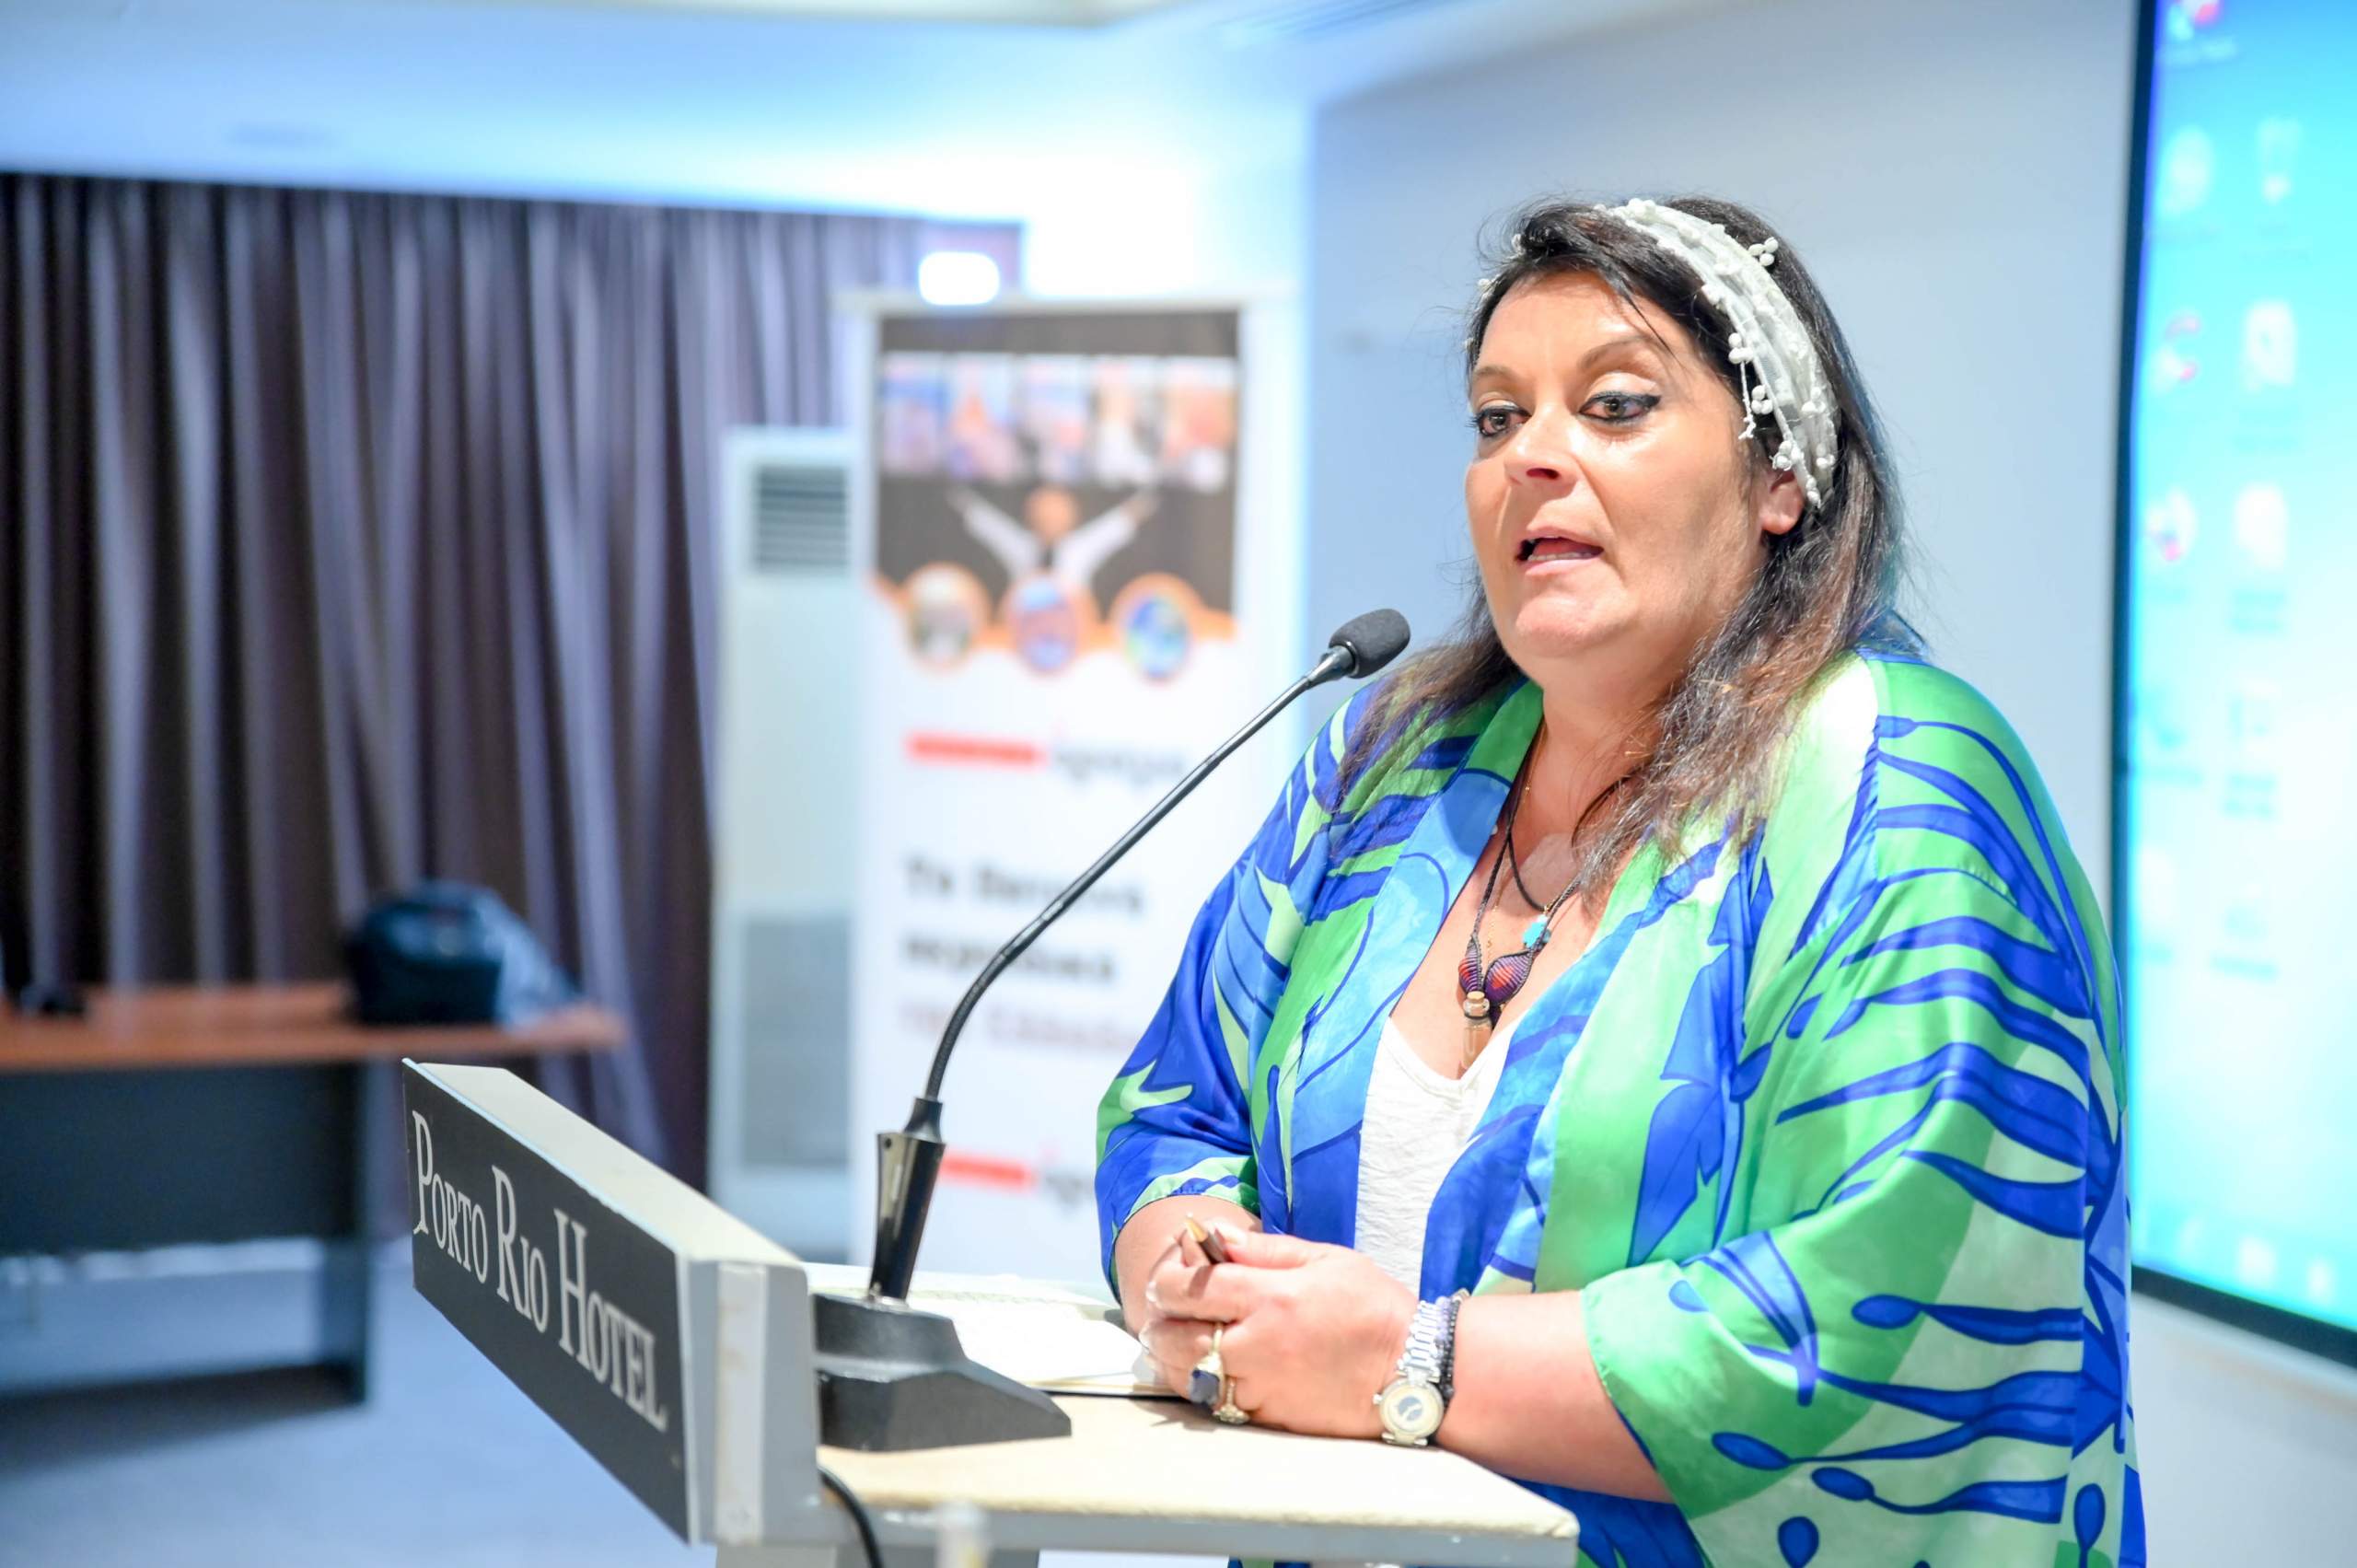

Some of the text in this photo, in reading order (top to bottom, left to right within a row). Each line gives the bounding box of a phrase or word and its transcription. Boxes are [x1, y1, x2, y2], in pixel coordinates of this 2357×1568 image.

[412, 1110, 668, 1433] PORTO RIO HOTEL
